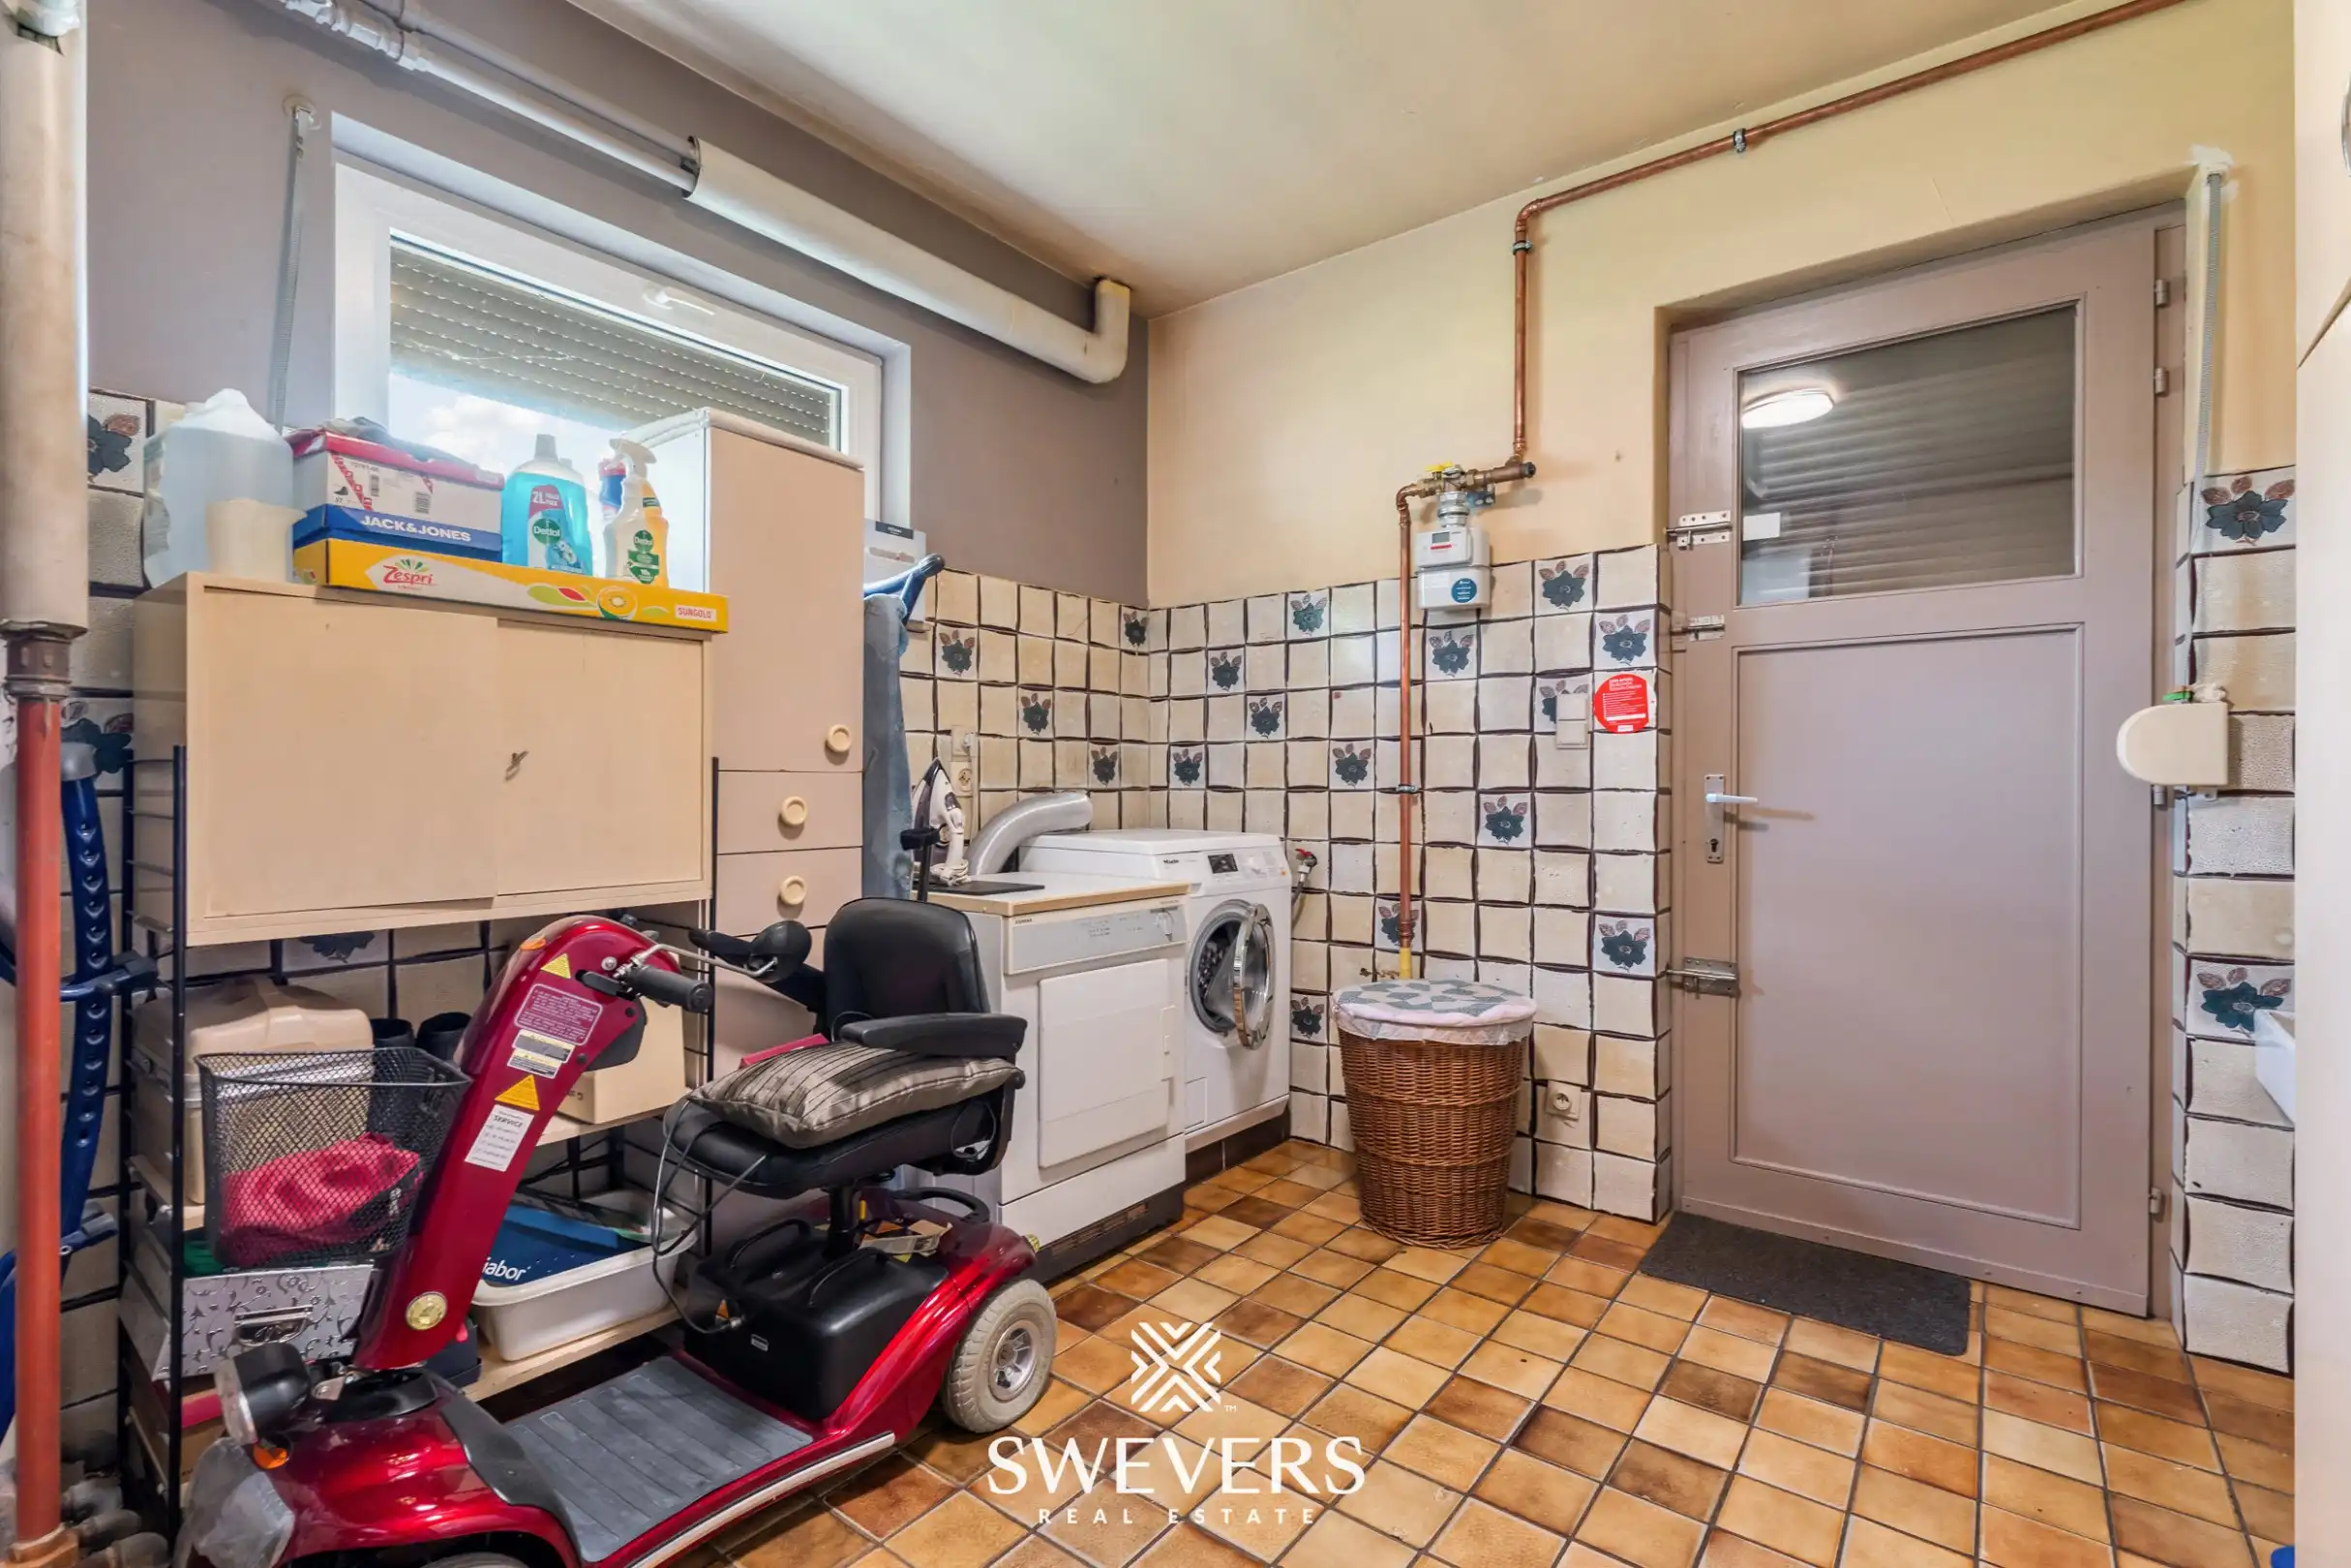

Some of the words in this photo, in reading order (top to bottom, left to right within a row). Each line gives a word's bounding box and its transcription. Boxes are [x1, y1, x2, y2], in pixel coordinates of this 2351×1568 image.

[360, 515, 472, 542] JACK&JONES
[533, 526, 560, 537] Dettol
[382, 564, 435, 586] Zespri
